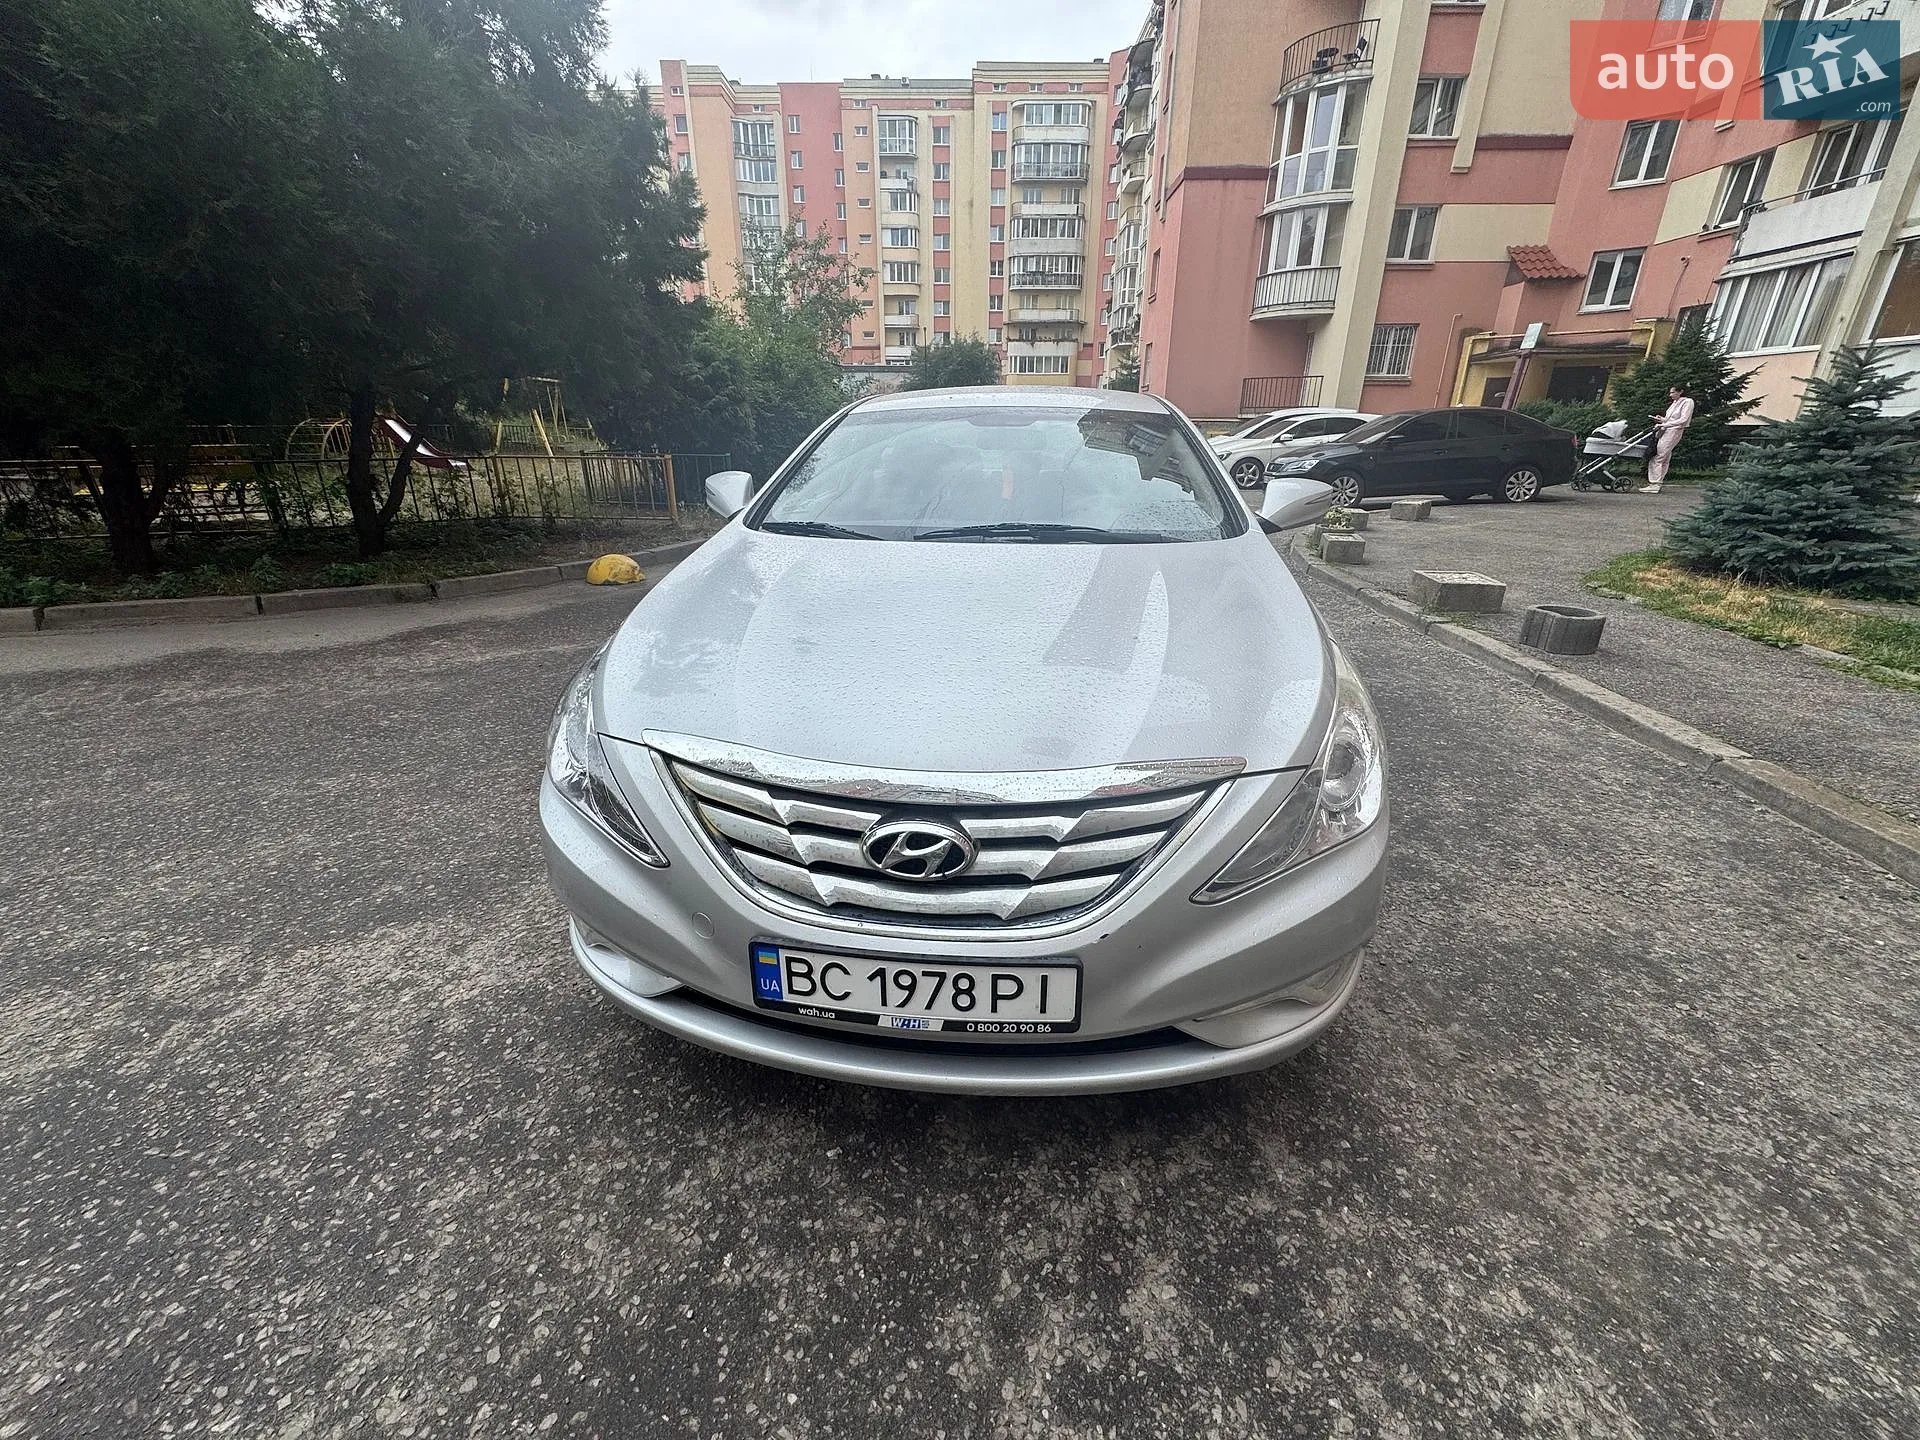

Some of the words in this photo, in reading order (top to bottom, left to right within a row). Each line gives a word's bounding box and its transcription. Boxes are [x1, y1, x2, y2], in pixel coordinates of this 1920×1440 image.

[760, 977, 780, 993] UA
[784, 955, 852, 1001] BC
[866, 966, 976, 1012] 1978
[989, 973, 1049, 1015] PI
[798, 1006, 836, 1019] wah.ua
[966, 1023, 975, 1032] 0
[977, 1023, 1000, 1033] 800
[1002, 1024, 1018, 1033] 20
[1019, 1024, 1035, 1033] 90
[1036, 1024, 1052, 1033] 86
